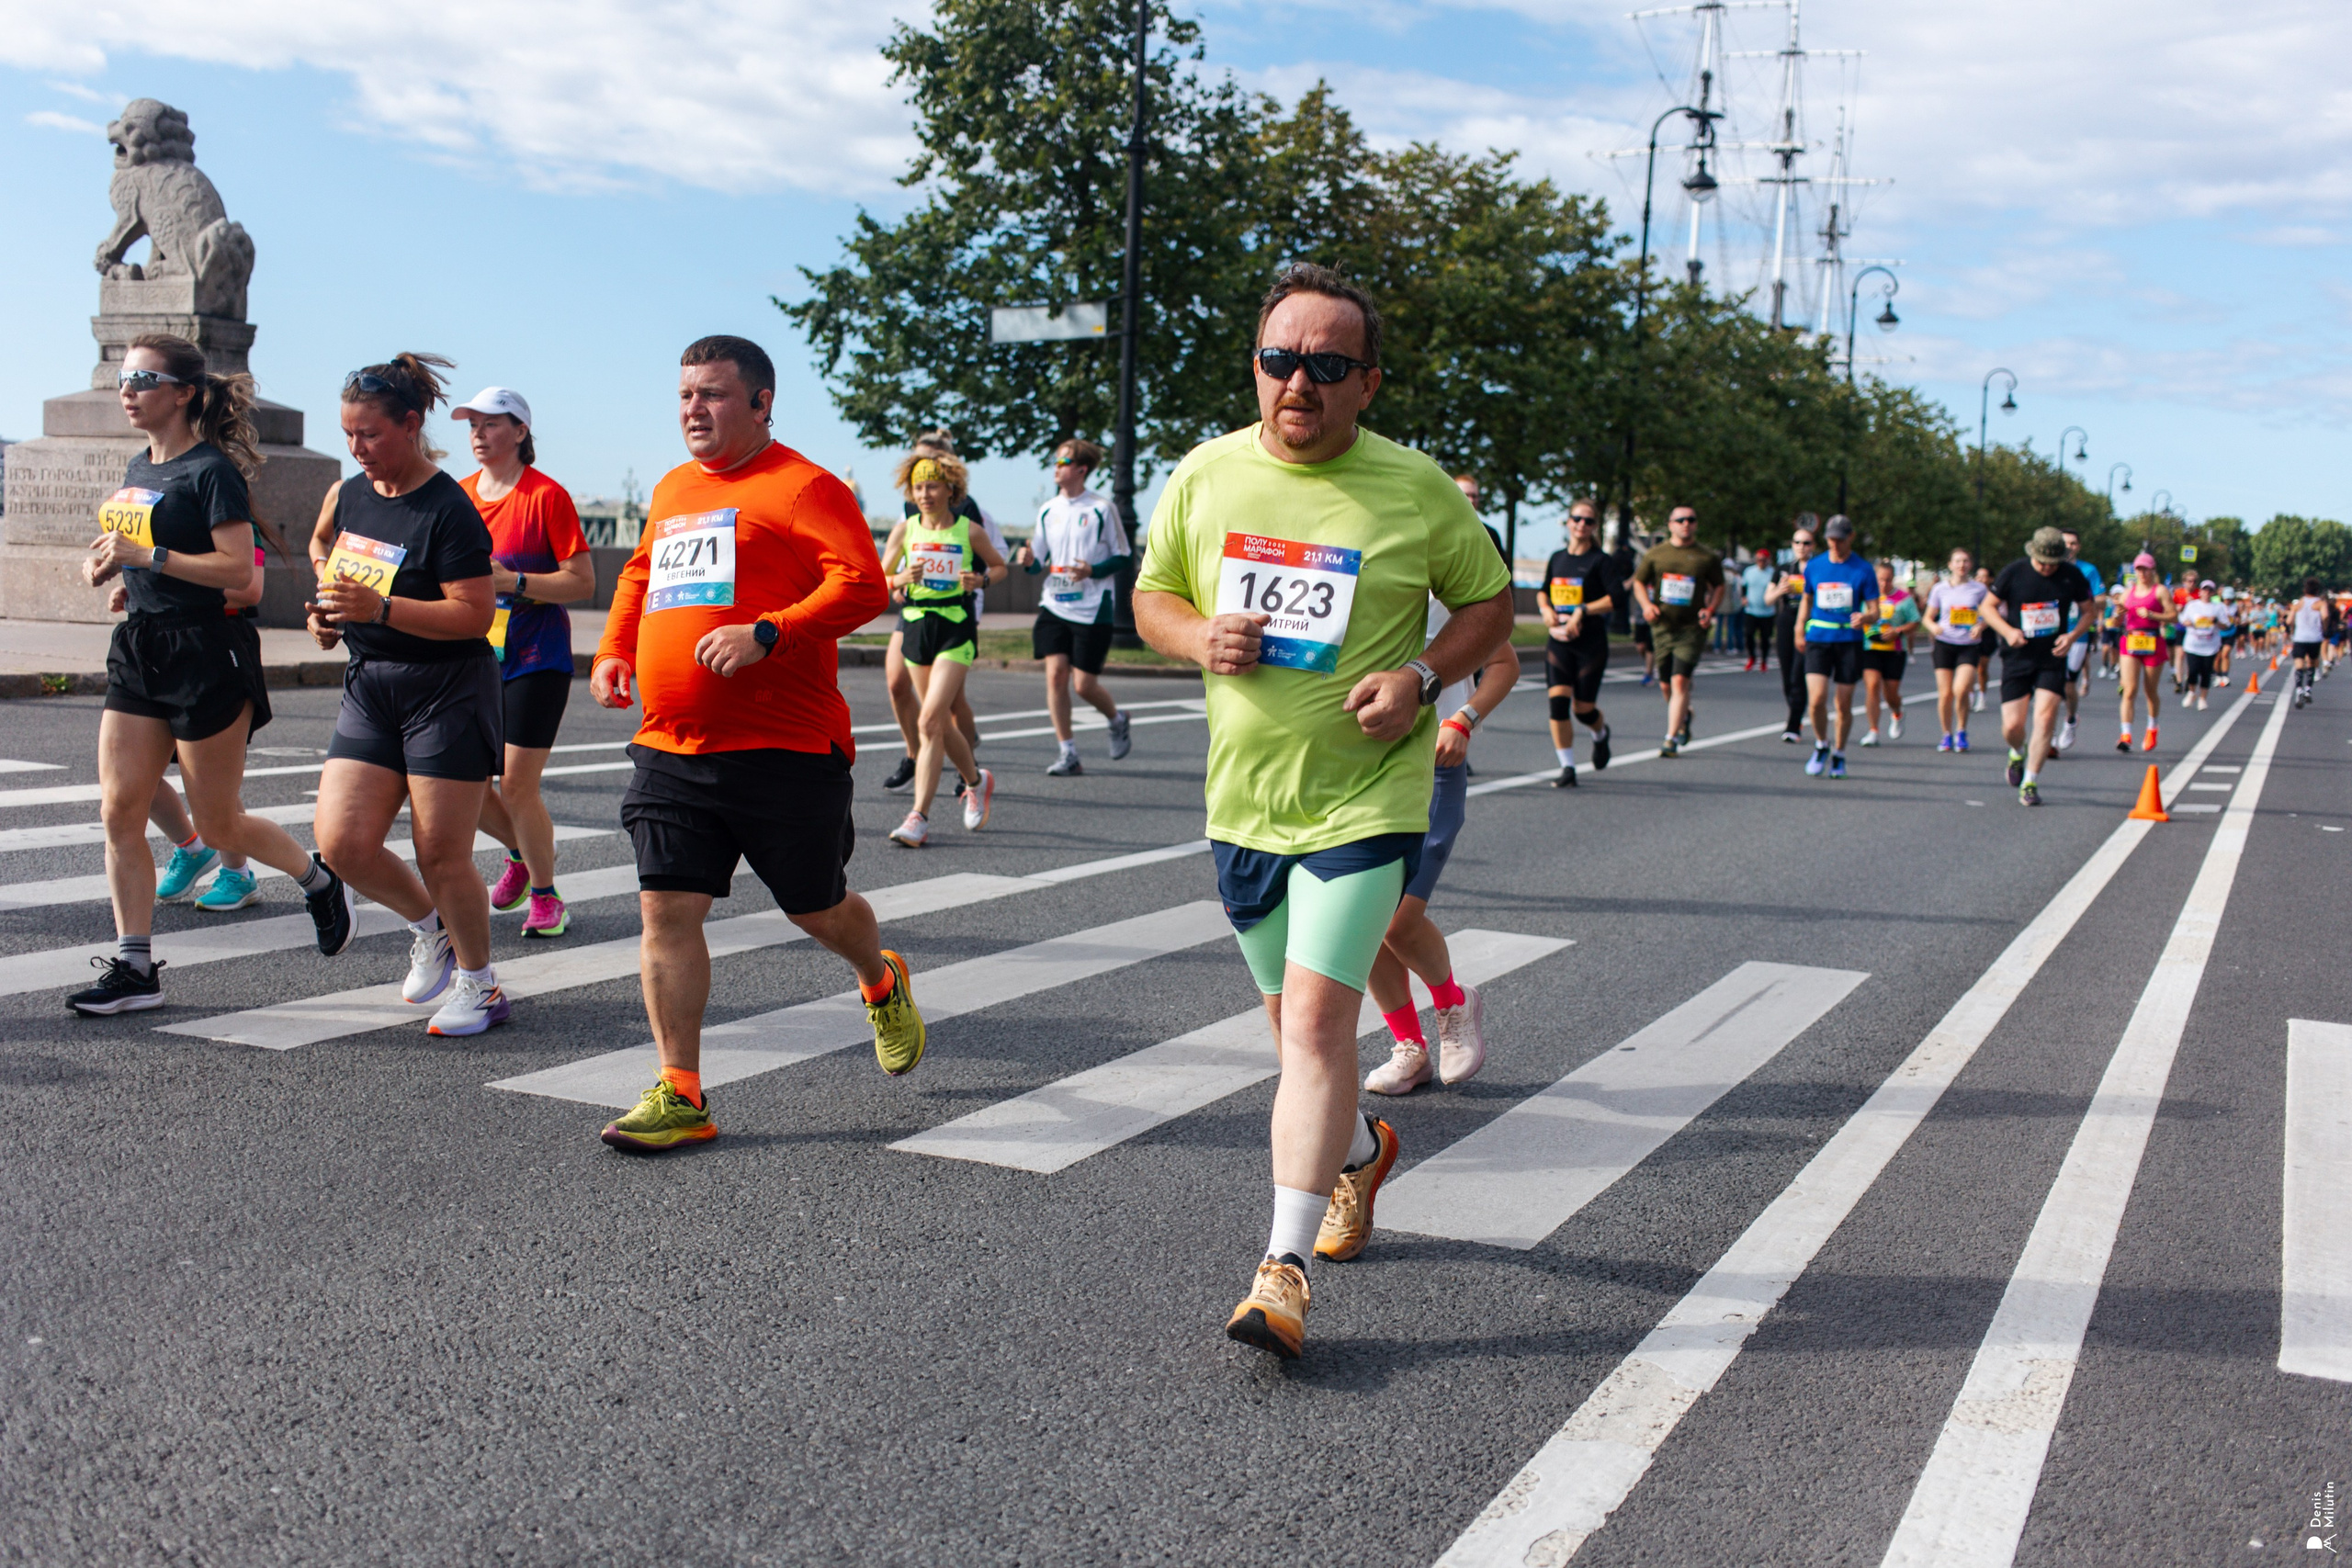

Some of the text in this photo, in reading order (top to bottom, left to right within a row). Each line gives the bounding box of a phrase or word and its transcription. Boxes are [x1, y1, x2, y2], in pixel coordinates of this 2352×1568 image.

[40, 468, 92, 481] ГОРОДА
[106, 509, 144, 536] 5237
[1244, 536, 1268, 547] ПОЛУ
[658, 536, 718, 570] 4271
[1243, 544, 1285, 558] МАРАФОН
[1303, 550, 1323, 563] 21,1
[333, 557, 384, 592] 5222
[666, 567, 706, 581] ЕВГЕНИЙ
[1239, 571, 1335, 619] 1623
[1269, 618, 1309, 632] ИТРИЙ
